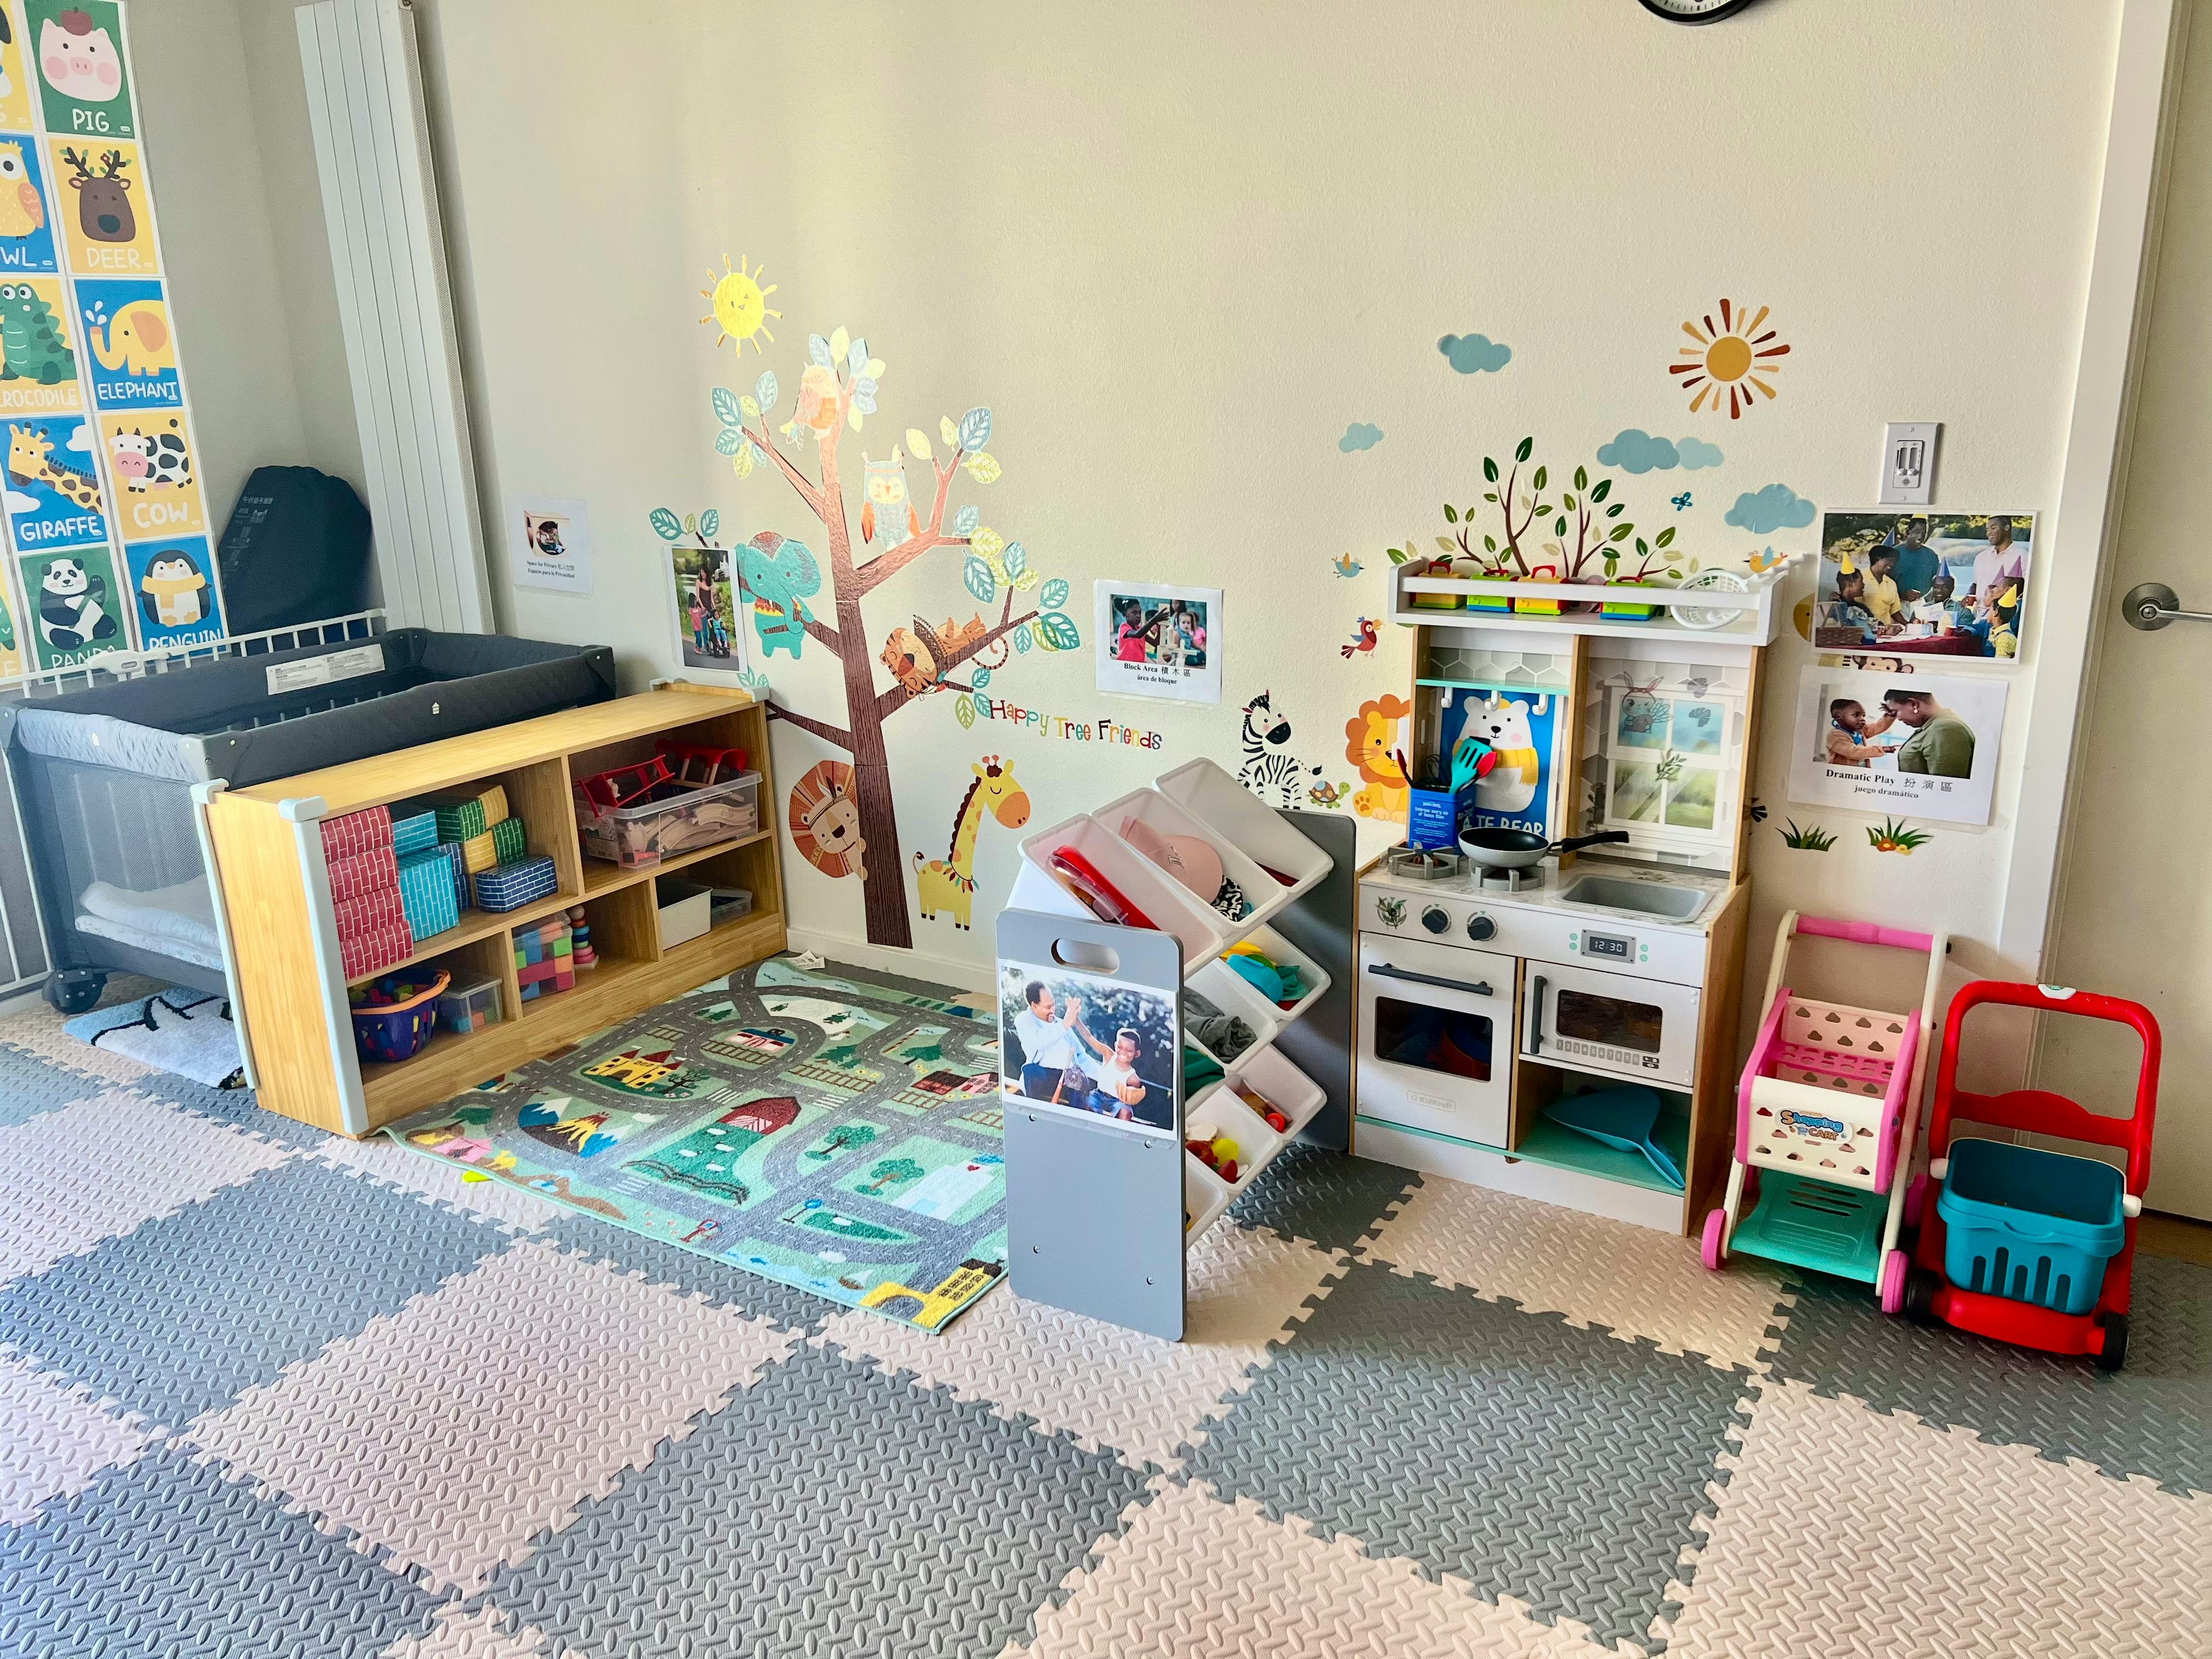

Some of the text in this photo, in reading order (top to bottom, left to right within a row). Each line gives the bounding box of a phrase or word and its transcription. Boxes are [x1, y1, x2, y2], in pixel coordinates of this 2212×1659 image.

[72, 108, 110, 132] PIG
[0, 245, 37, 267] WL
[86, 247, 142, 268] DEER
[0, 388, 78, 407] ROCODILE
[97, 381, 177, 400] ELEPHANT
[133, 502, 188, 528] COW
[20, 516, 101, 541] GIRAFFE
[989, 699, 1162, 750] Happy Tree Friends
[1826, 769, 1953, 792] Dramatic Play 扮演區
[1854, 785, 1919, 799] juego dramático
[1595, 940, 1623, 952] 12:30
[1419, 1097, 1451, 1109] KidKraft
[1780, 1110, 1843, 1133] Shopping
[1808, 1128, 1838, 1141] CART
